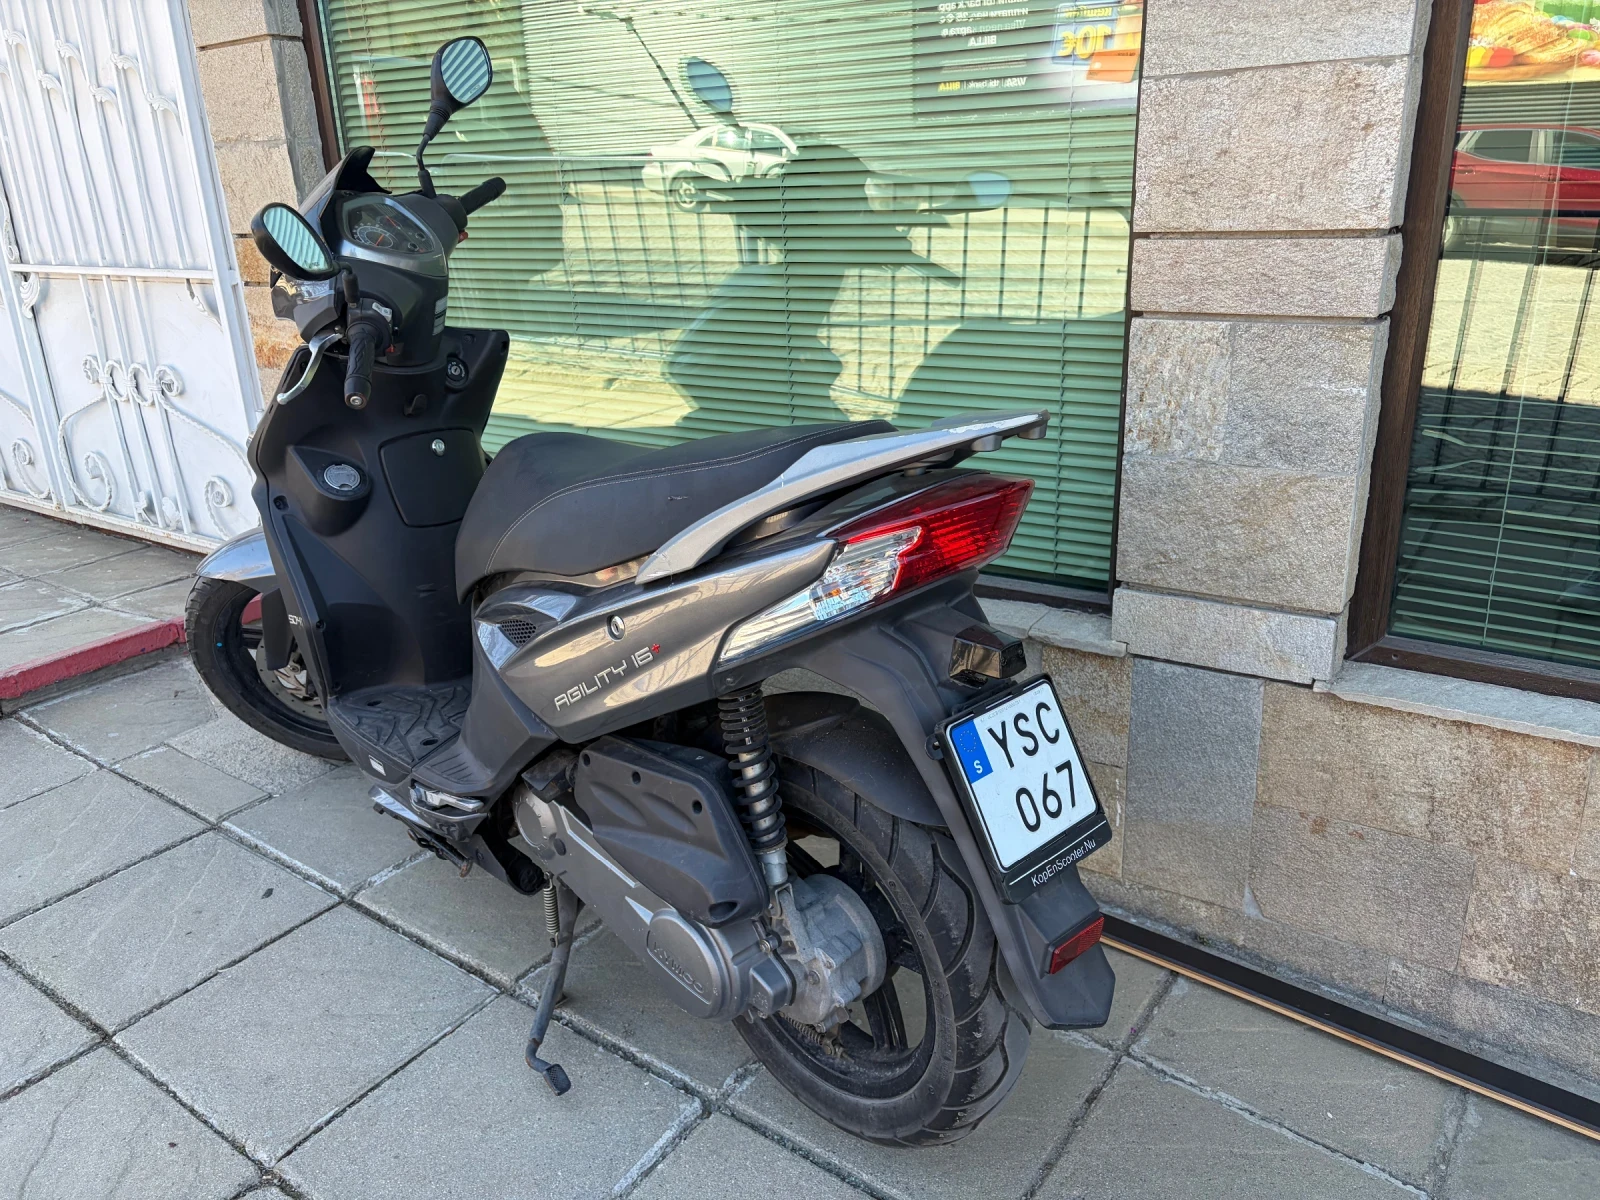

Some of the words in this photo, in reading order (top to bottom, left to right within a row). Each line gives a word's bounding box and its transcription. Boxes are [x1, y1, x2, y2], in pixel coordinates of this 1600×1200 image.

[554, 660, 628, 711] AGILITY
[987, 702, 1060, 768] YSC
[973, 760, 983, 774] S
[1015, 760, 1077, 832] 067
[1031, 839, 1097, 887] KopEnScooter.Nu
